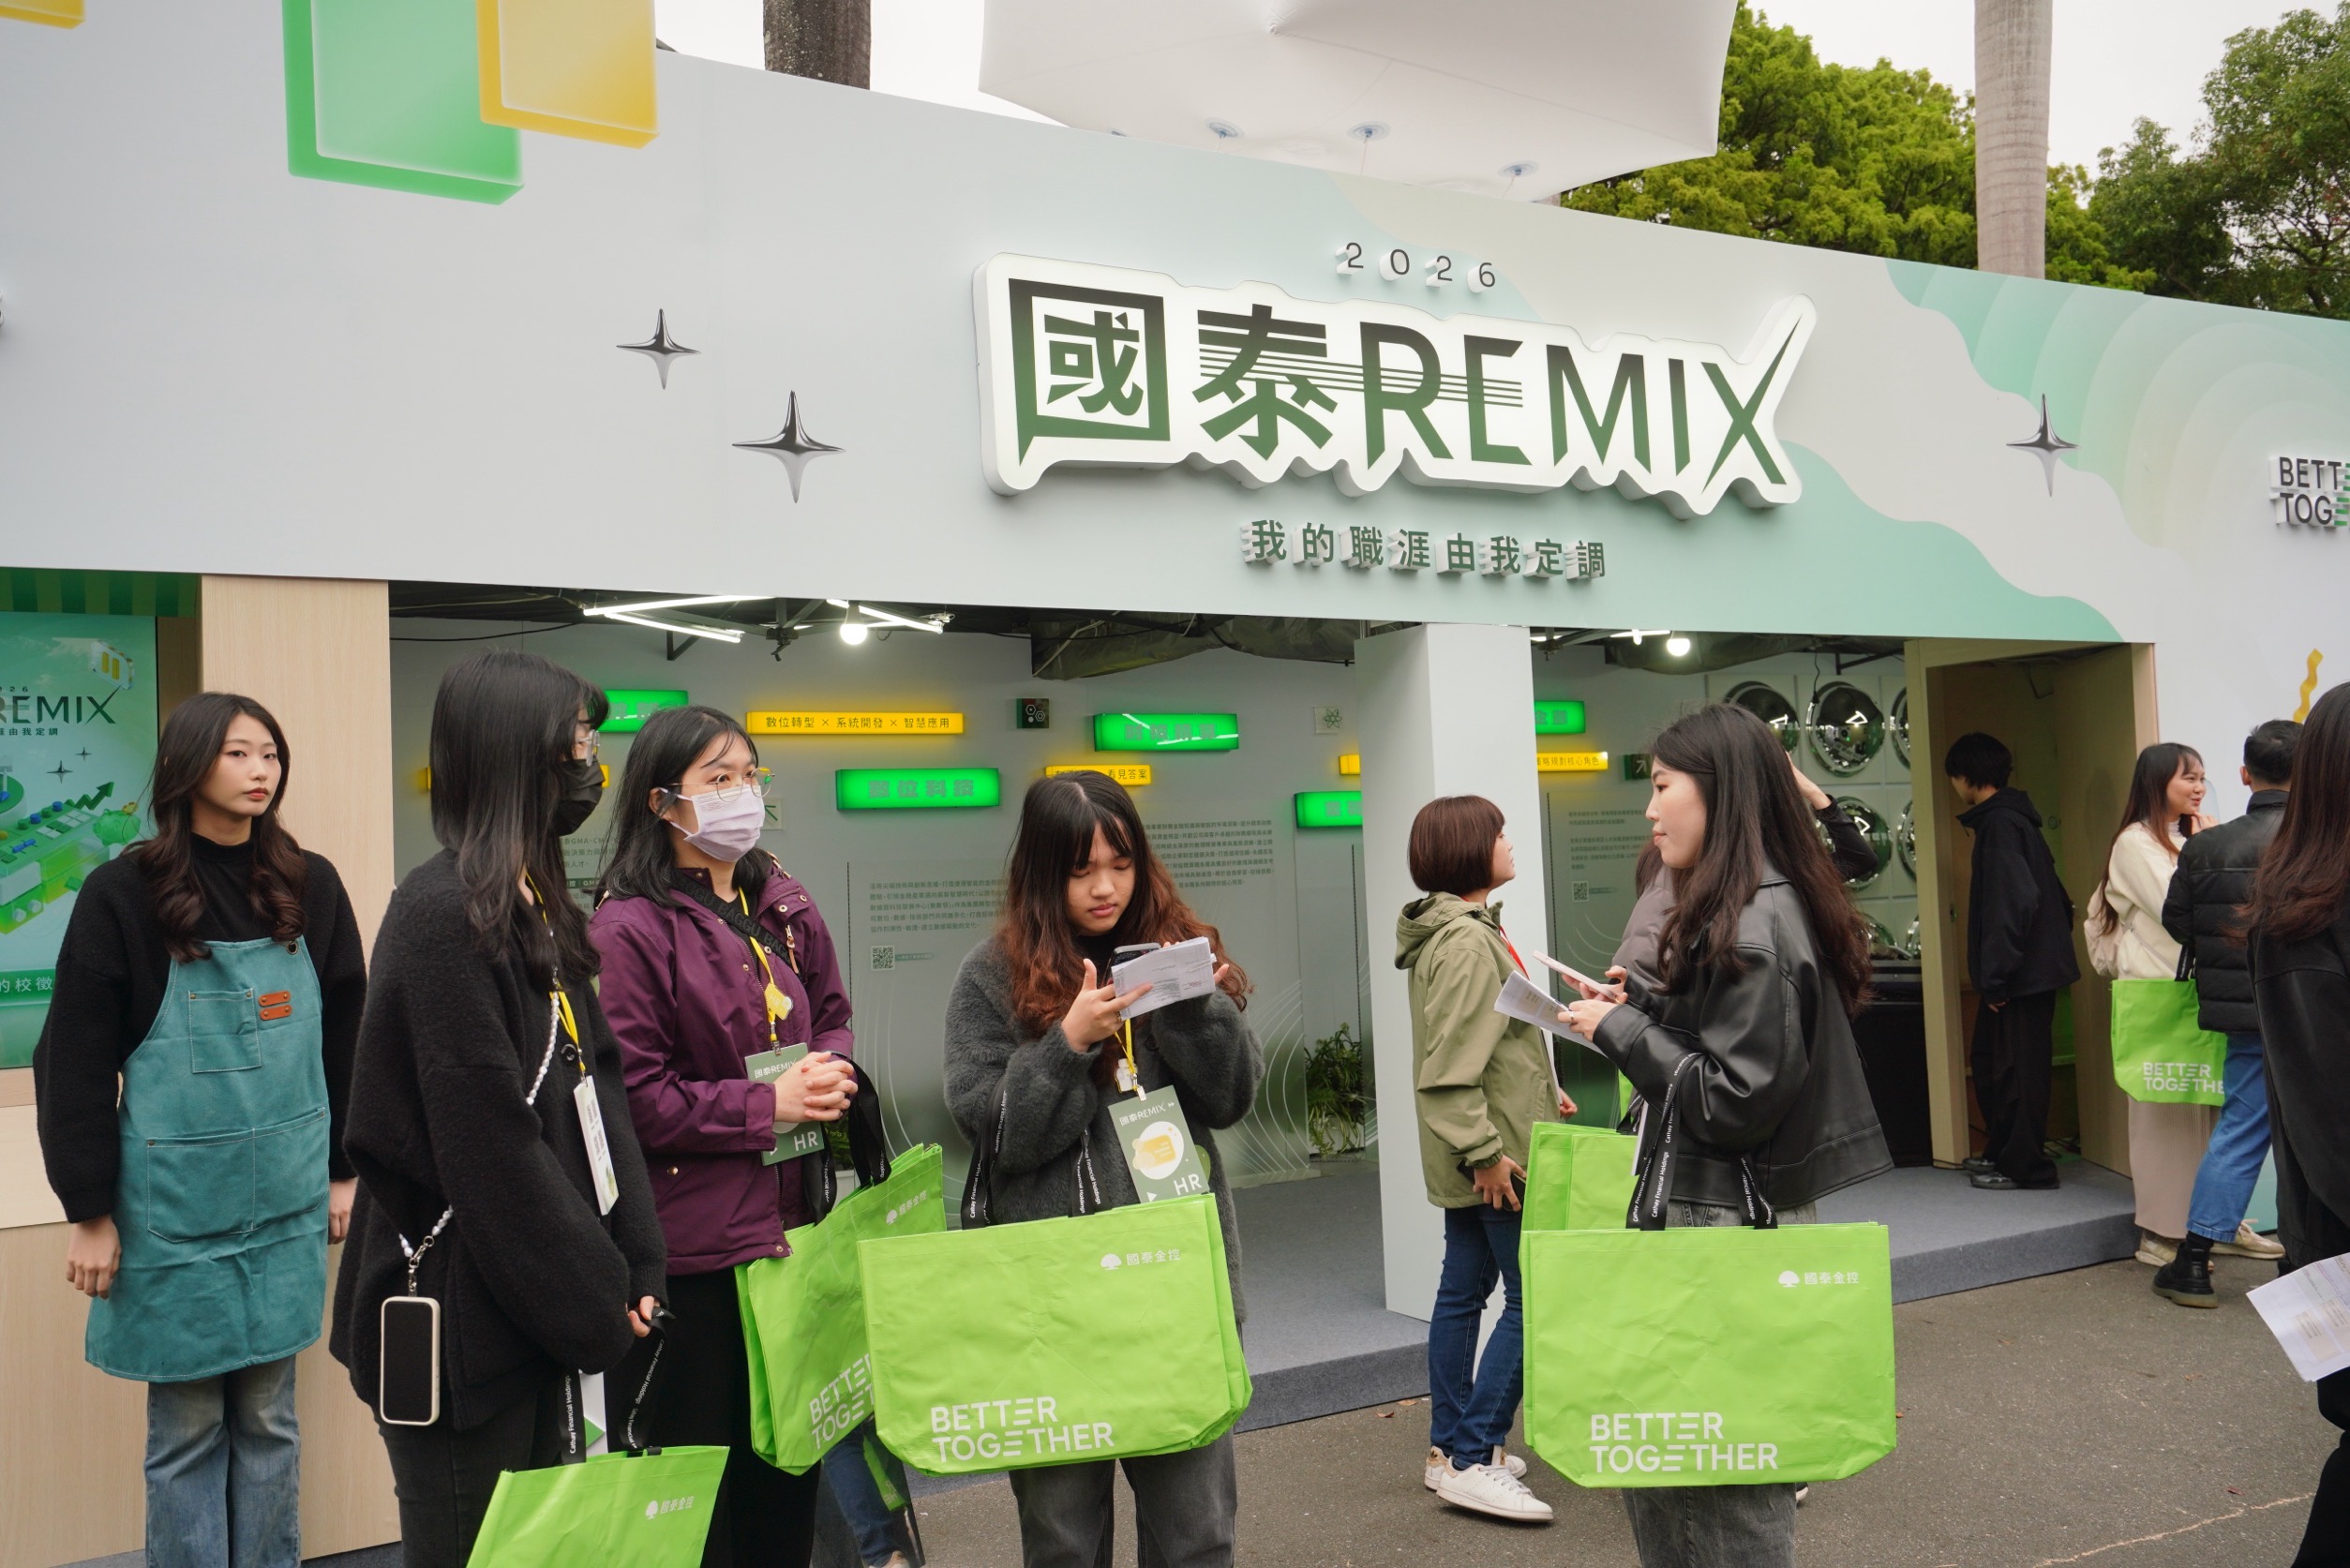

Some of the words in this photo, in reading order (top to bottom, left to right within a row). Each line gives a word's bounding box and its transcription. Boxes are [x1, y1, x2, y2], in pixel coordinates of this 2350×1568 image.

[1345, 242, 1496, 288] 2026
[1008, 277, 1806, 495] 國泰REMIX
[1249, 518, 1607, 579] 我的職涯由我定調
[765, 716, 815, 728] 數位轉型
[836, 716, 883, 728] 系統開發
[904, 716, 950, 728] 智慧應用
[718, 901, 761, 936] BAGGU
[2143, 1061, 2212, 1079] BETTER
[1118, 1101, 1166, 1127] 國泰REMIX
[794, 1130, 819, 1152] HR
[1665, 1124, 1673, 1143] Cathay
[1659, 1151, 1669, 1175] Holdings
[1086, 1158, 1097, 1182] Financial
[1092, 1181, 1101, 1205] Holdings
[1174, 1173, 1203, 1196] HR
[1654, 1175, 1665, 1199] Financial
[899, 1189, 928, 1217] 國泰金控
[1652, 1199, 1661, 1217] Cathay
[1746, 1195, 1756, 1220] Holdings
[1126, 1248, 1181, 1266] 國泰金控
[1804, 1270, 1860, 1286] 國泰金控
[565, 1403, 575, 1432] Financial
[930, 1396, 1058, 1434] BETTER
[1591, 1411, 1724, 1442] BETTER
[932, 1422, 1115, 1463] TOGETHER
[1589, 1442, 1778, 1473] TOGETHER
[660, 1495, 696, 1515] 國泰金控
